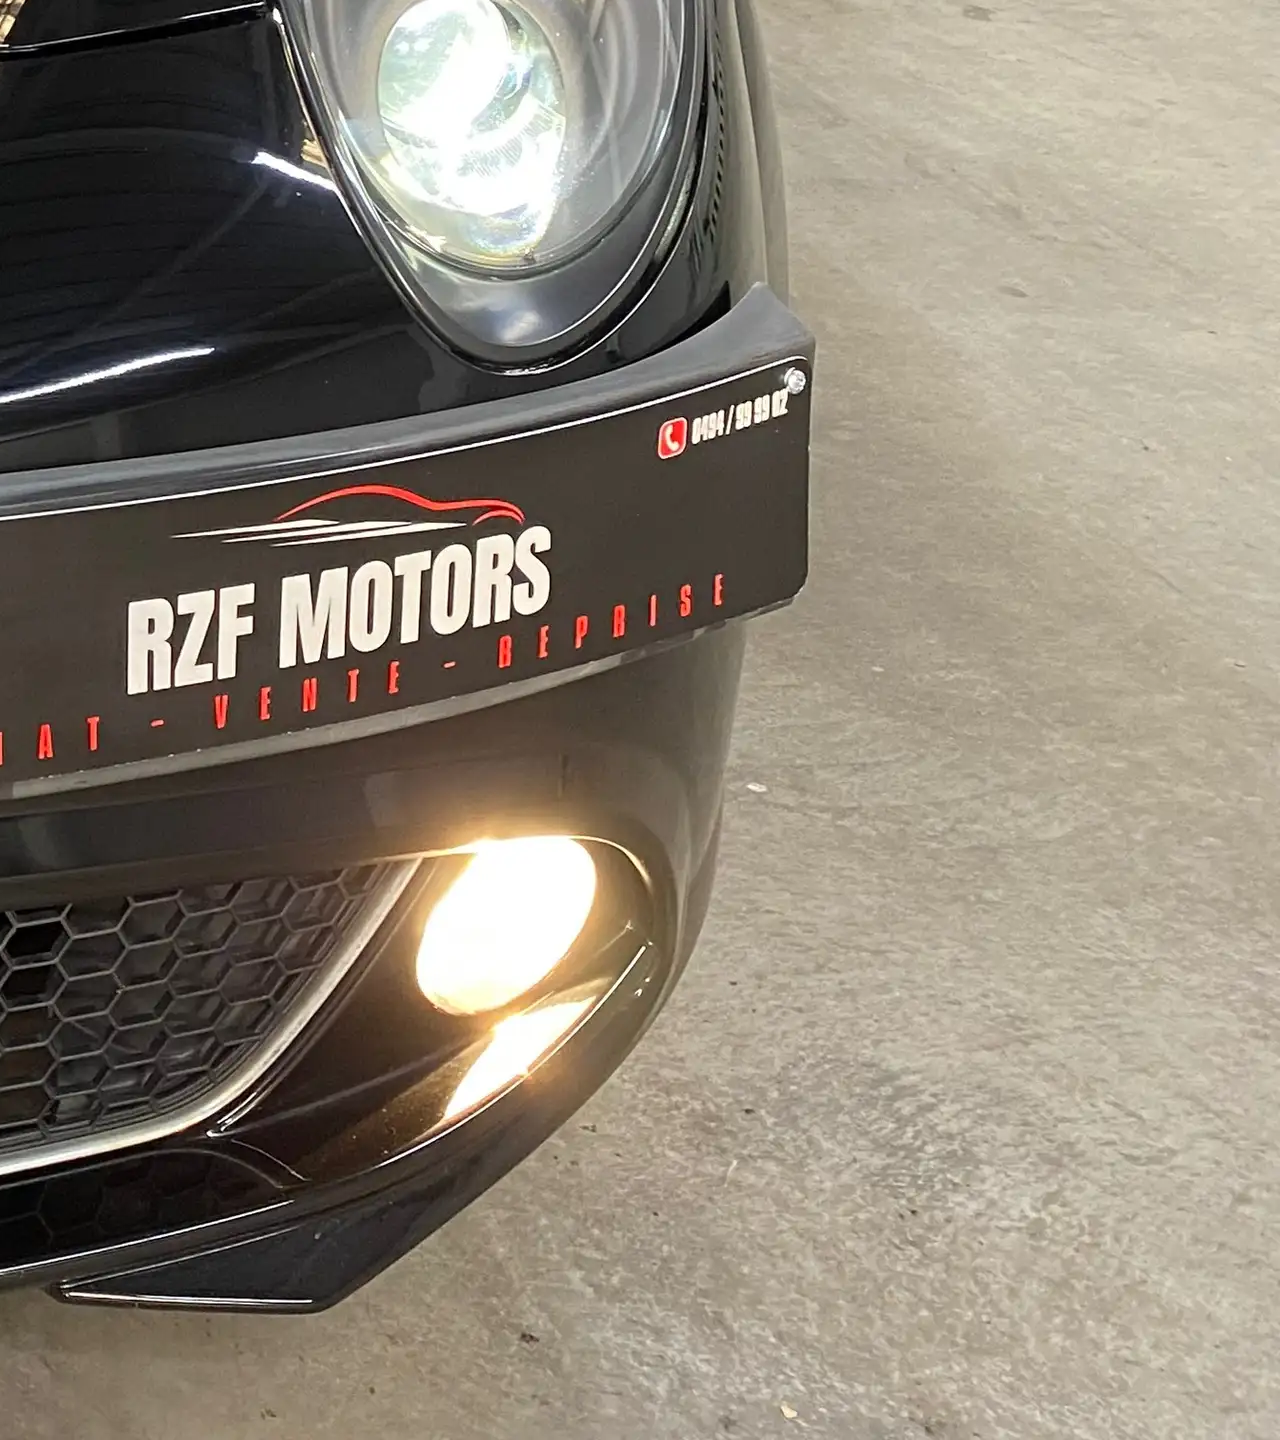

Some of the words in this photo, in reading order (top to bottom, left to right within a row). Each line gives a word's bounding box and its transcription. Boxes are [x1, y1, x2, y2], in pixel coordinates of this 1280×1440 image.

[128, 587, 256, 695] RZF
[279, 525, 552, 668] MOTORS
[213, 660, 401, 730] VENTE
[497, 573, 725, 669] REPRISE
